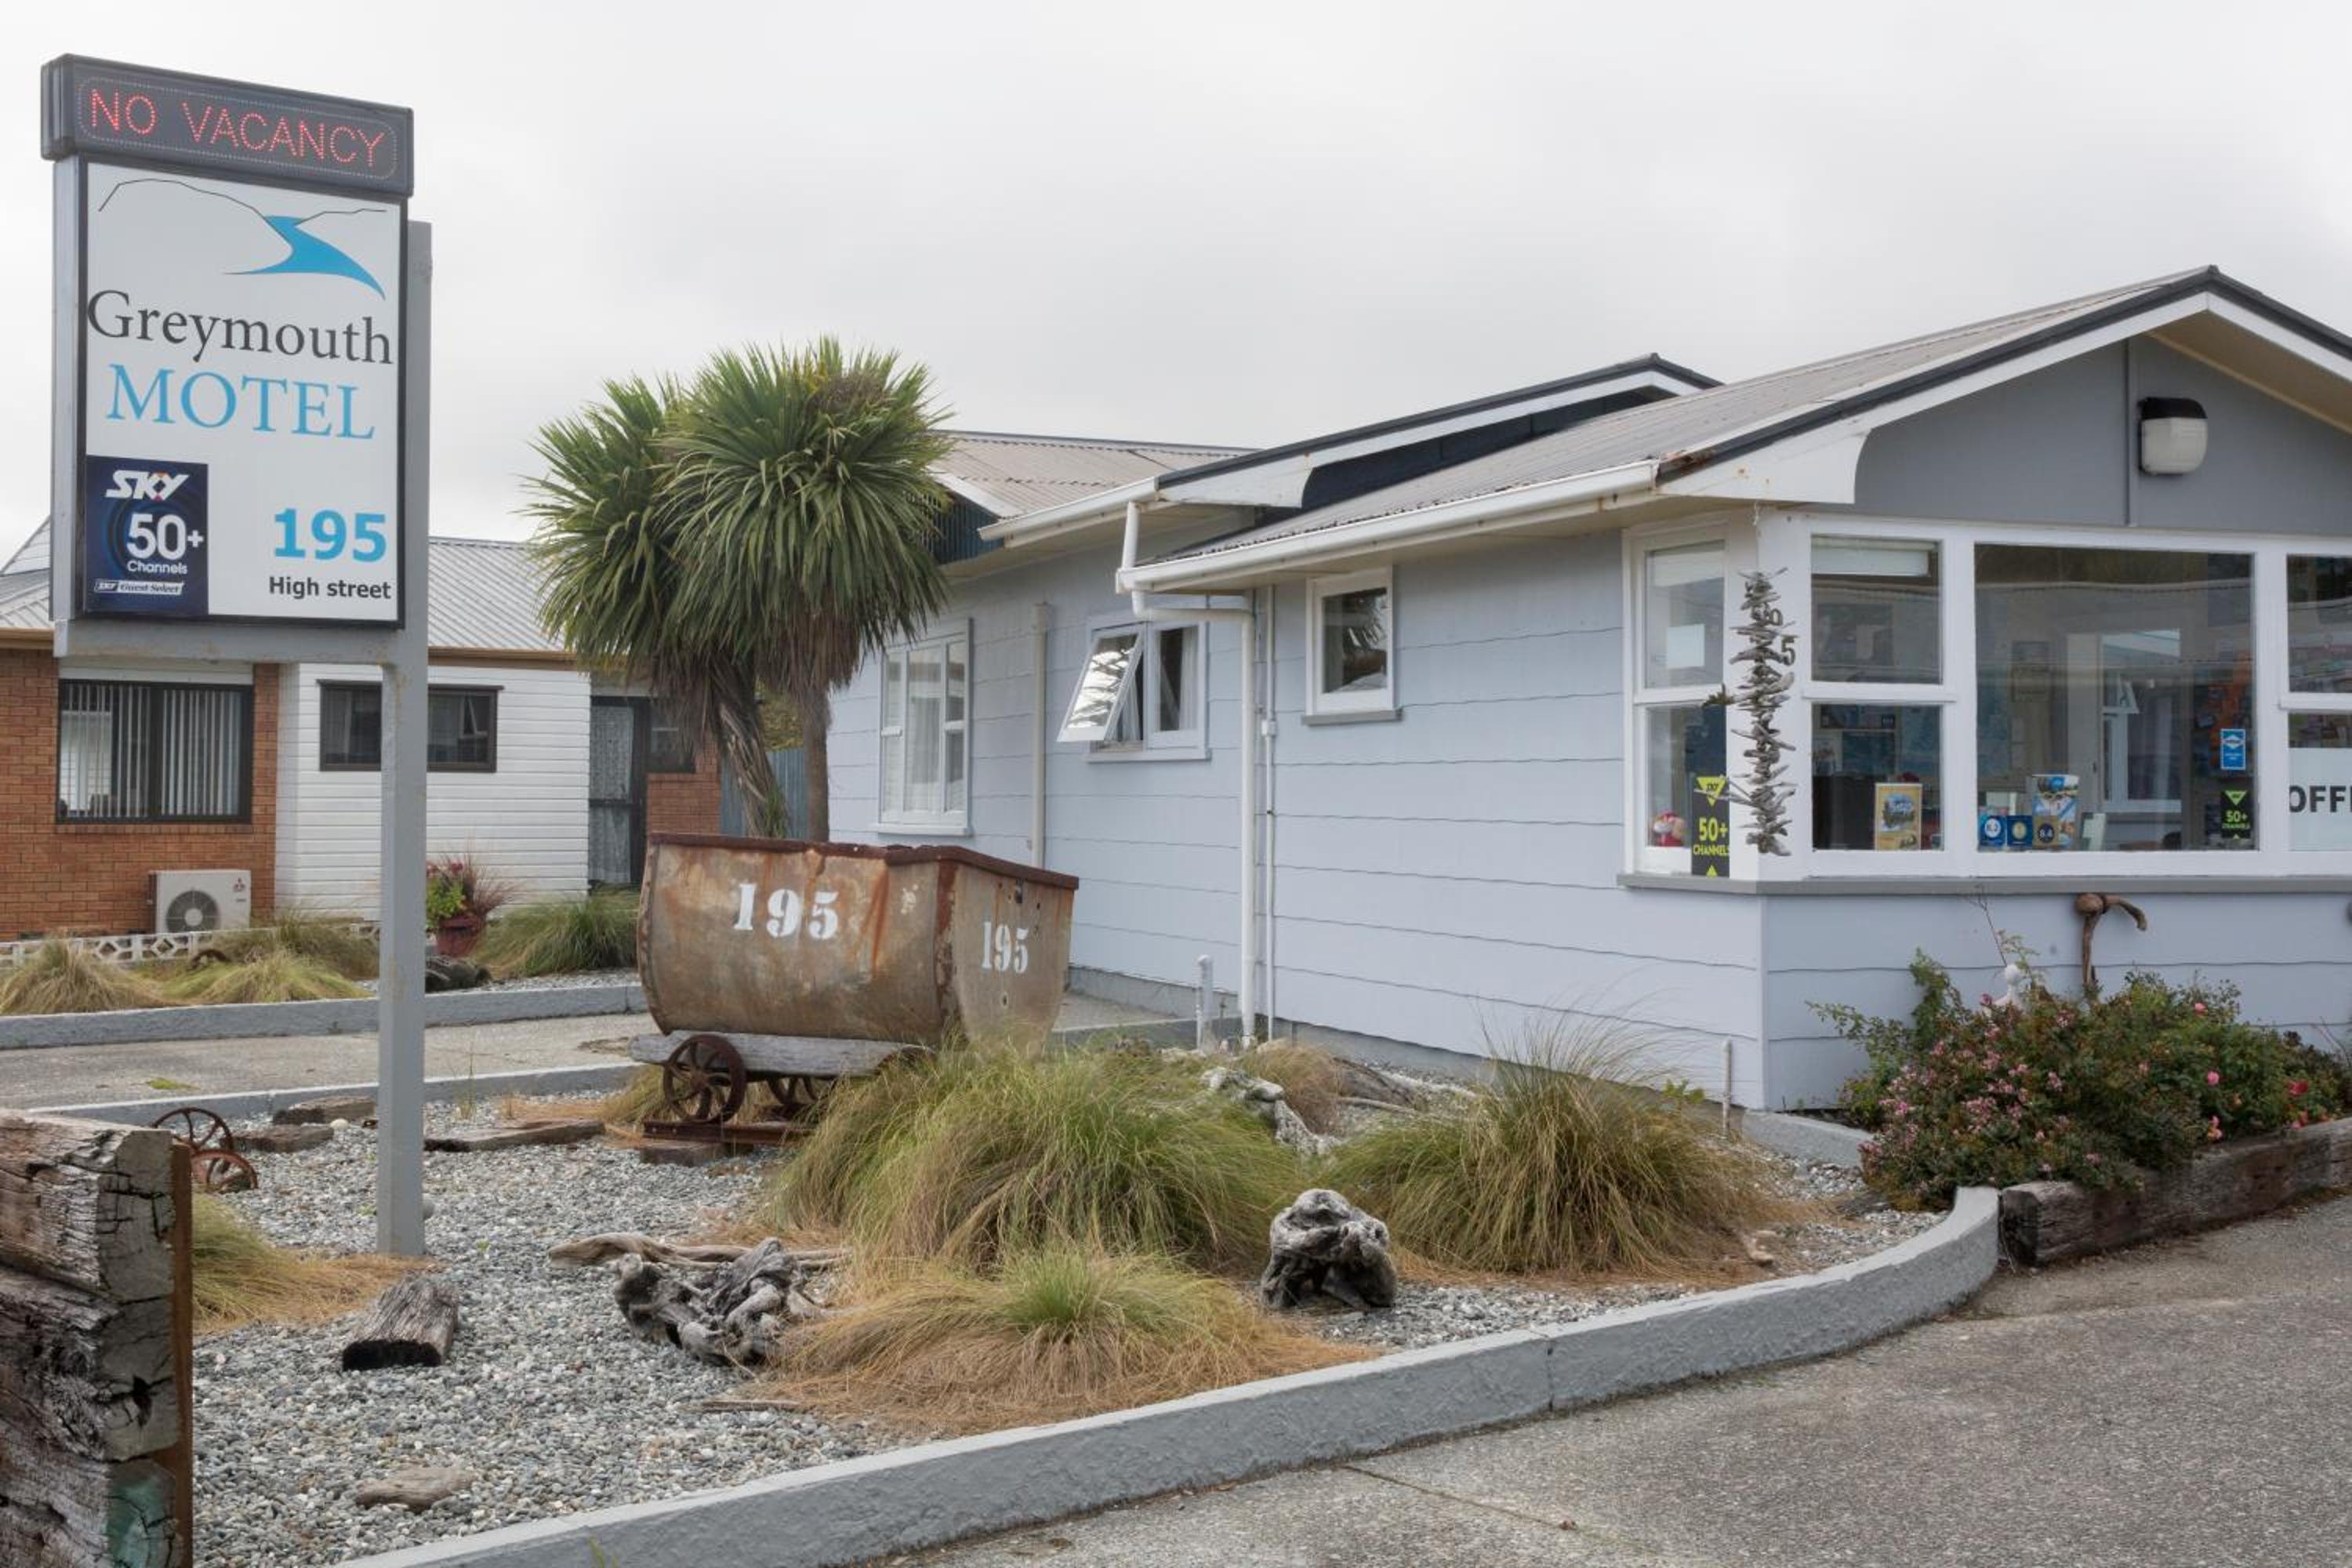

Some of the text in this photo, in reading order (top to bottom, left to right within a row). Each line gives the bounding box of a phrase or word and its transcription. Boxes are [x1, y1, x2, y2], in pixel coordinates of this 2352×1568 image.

[90, 87, 386, 168] NO VACANCY
[87, 289, 394, 365] Greymouth
[105, 363, 376, 440] MOTEL
[105, 470, 190, 502] SKY
[126, 513, 204, 561] 50+
[274, 507, 387, 562] 195
[127, 560, 188, 575] Channels
[269, 576, 392, 600] High street
[1698, 818, 1728, 841] 50+
[733, 883, 839, 940] 195
[982, 921, 1029, 974] 195
